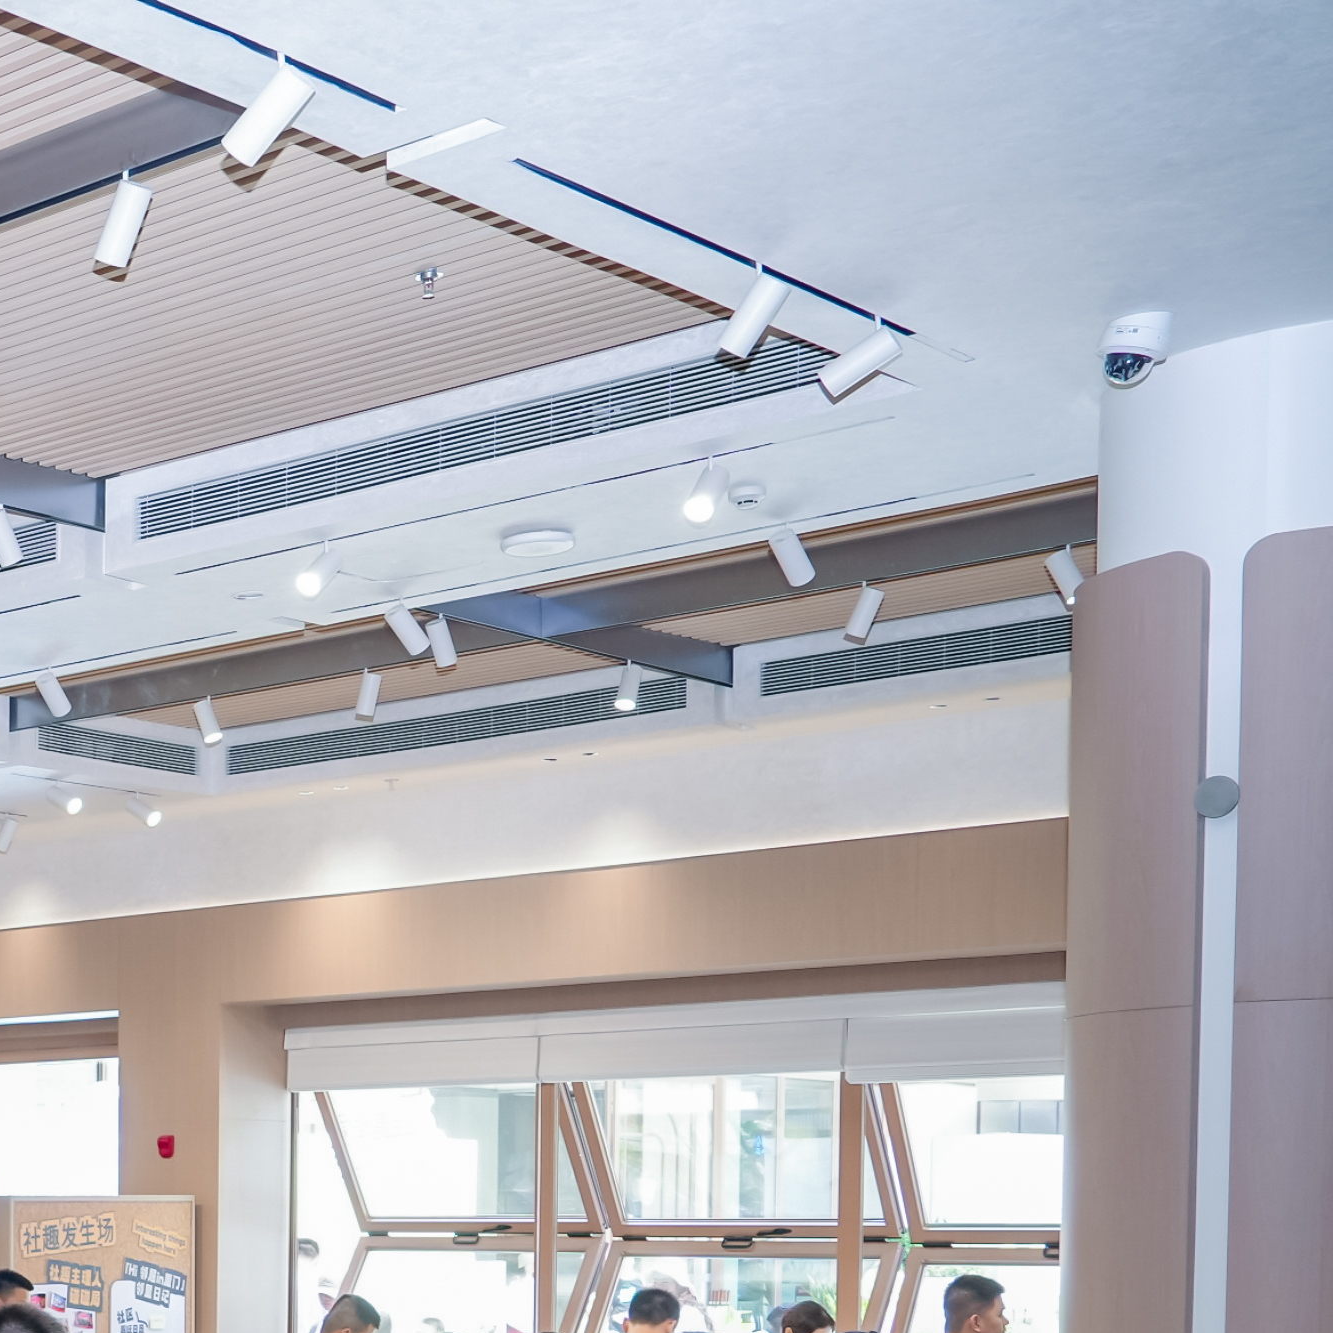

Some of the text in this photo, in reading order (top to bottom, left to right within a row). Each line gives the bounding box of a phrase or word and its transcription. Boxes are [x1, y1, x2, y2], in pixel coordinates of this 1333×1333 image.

[23, 1216, 115, 1254] 社趣发生场
